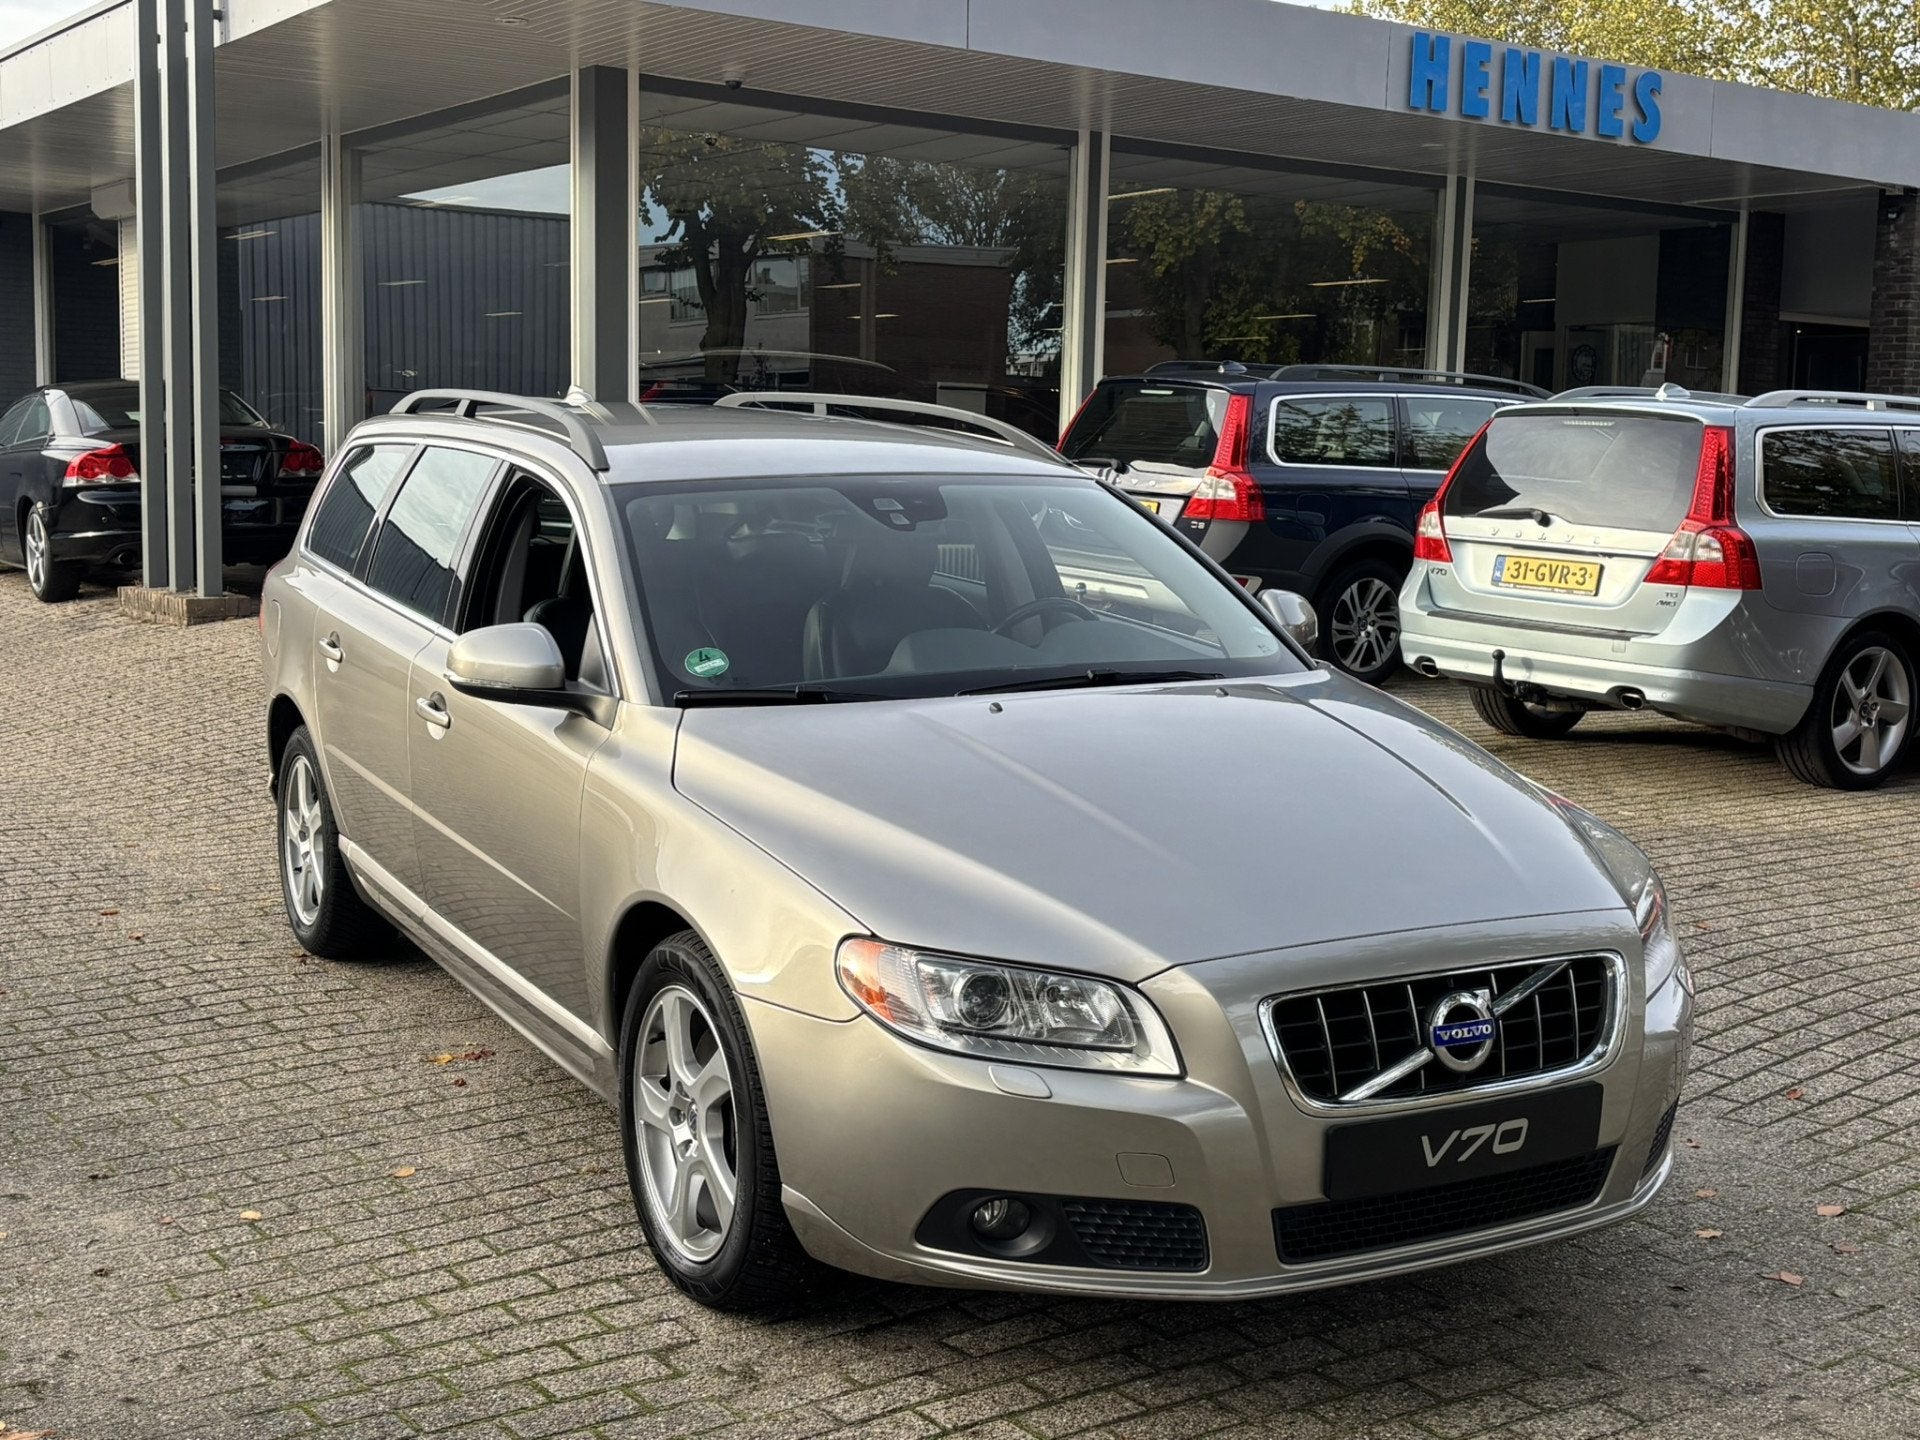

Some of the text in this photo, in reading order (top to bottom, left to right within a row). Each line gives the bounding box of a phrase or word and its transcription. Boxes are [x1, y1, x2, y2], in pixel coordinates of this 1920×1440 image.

[1410, 32, 1662, 143] HENNES
[1509, 560, 1588, 586] 31-GVR-3
[1436, 1024, 1492, 1041] VOLVO
[1420, 1118, 1529, 1168] V70
